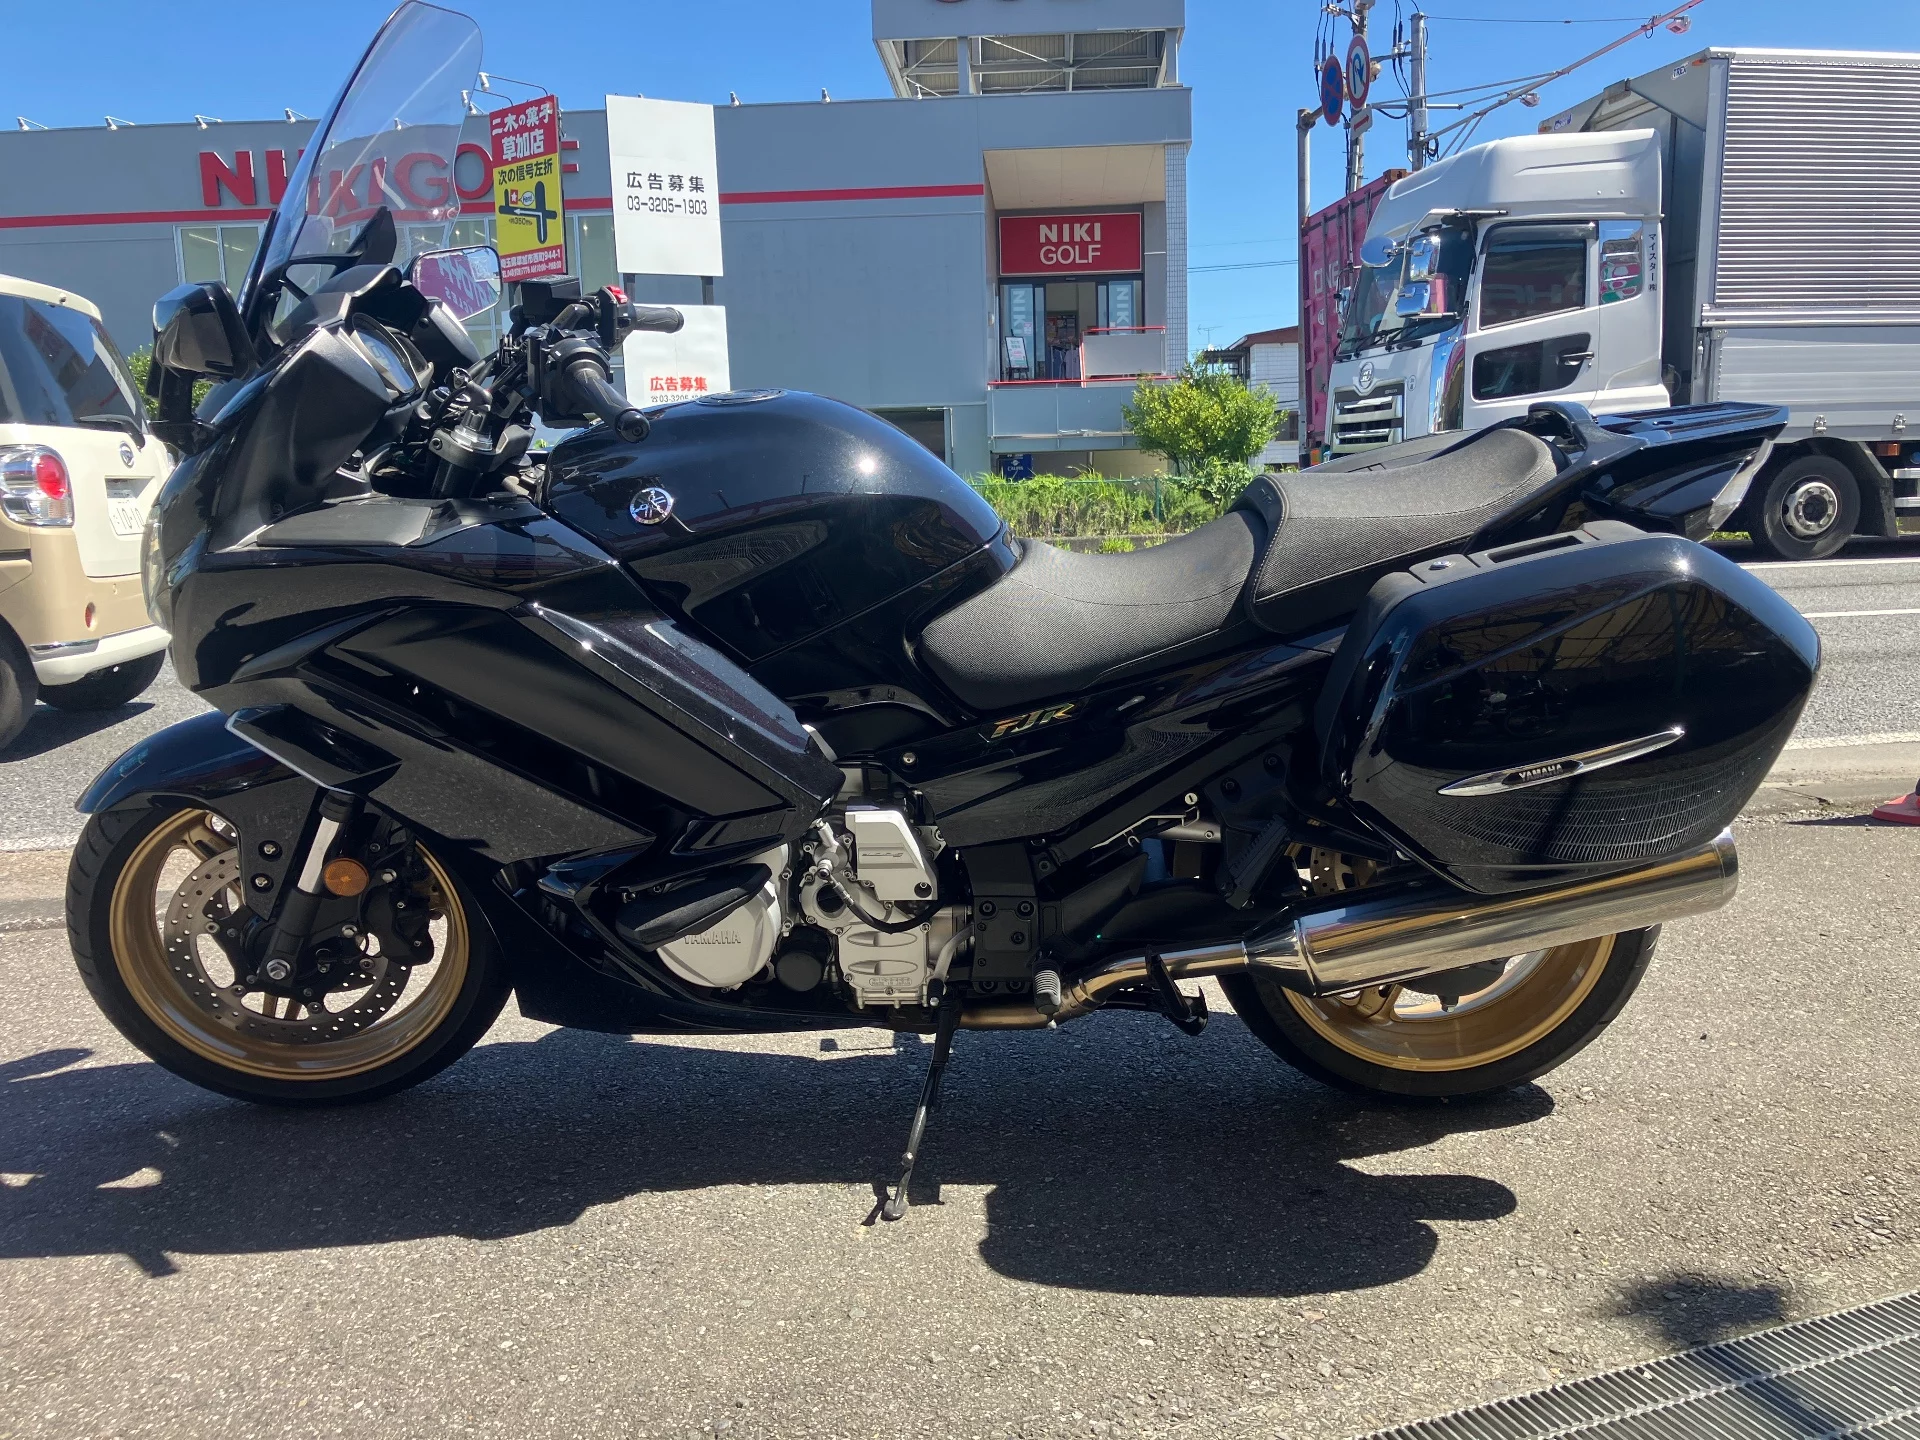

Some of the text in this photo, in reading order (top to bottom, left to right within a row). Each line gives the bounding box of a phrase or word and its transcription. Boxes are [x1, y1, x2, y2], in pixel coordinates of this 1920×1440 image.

[492, 102, 553, 136] 二木の菓子
[502, 128, 545, 162] 草加店
[498, 157, 554, 186] 次の信号左折
[626, 171, 705, 194] 広告募集
[627, 195, 708, 216] 03-3205-1903
[1039, 222, 1102, 244] NIKI
[1039, 244, 1102, 265] GOLF
[1314, 260, 1340, 294] ONE
[650, 376, 708, 392] 広告募集
[1518, 763, 1564, 782] YAMAHA
[684, 929, 742, 945] YAMAHA
